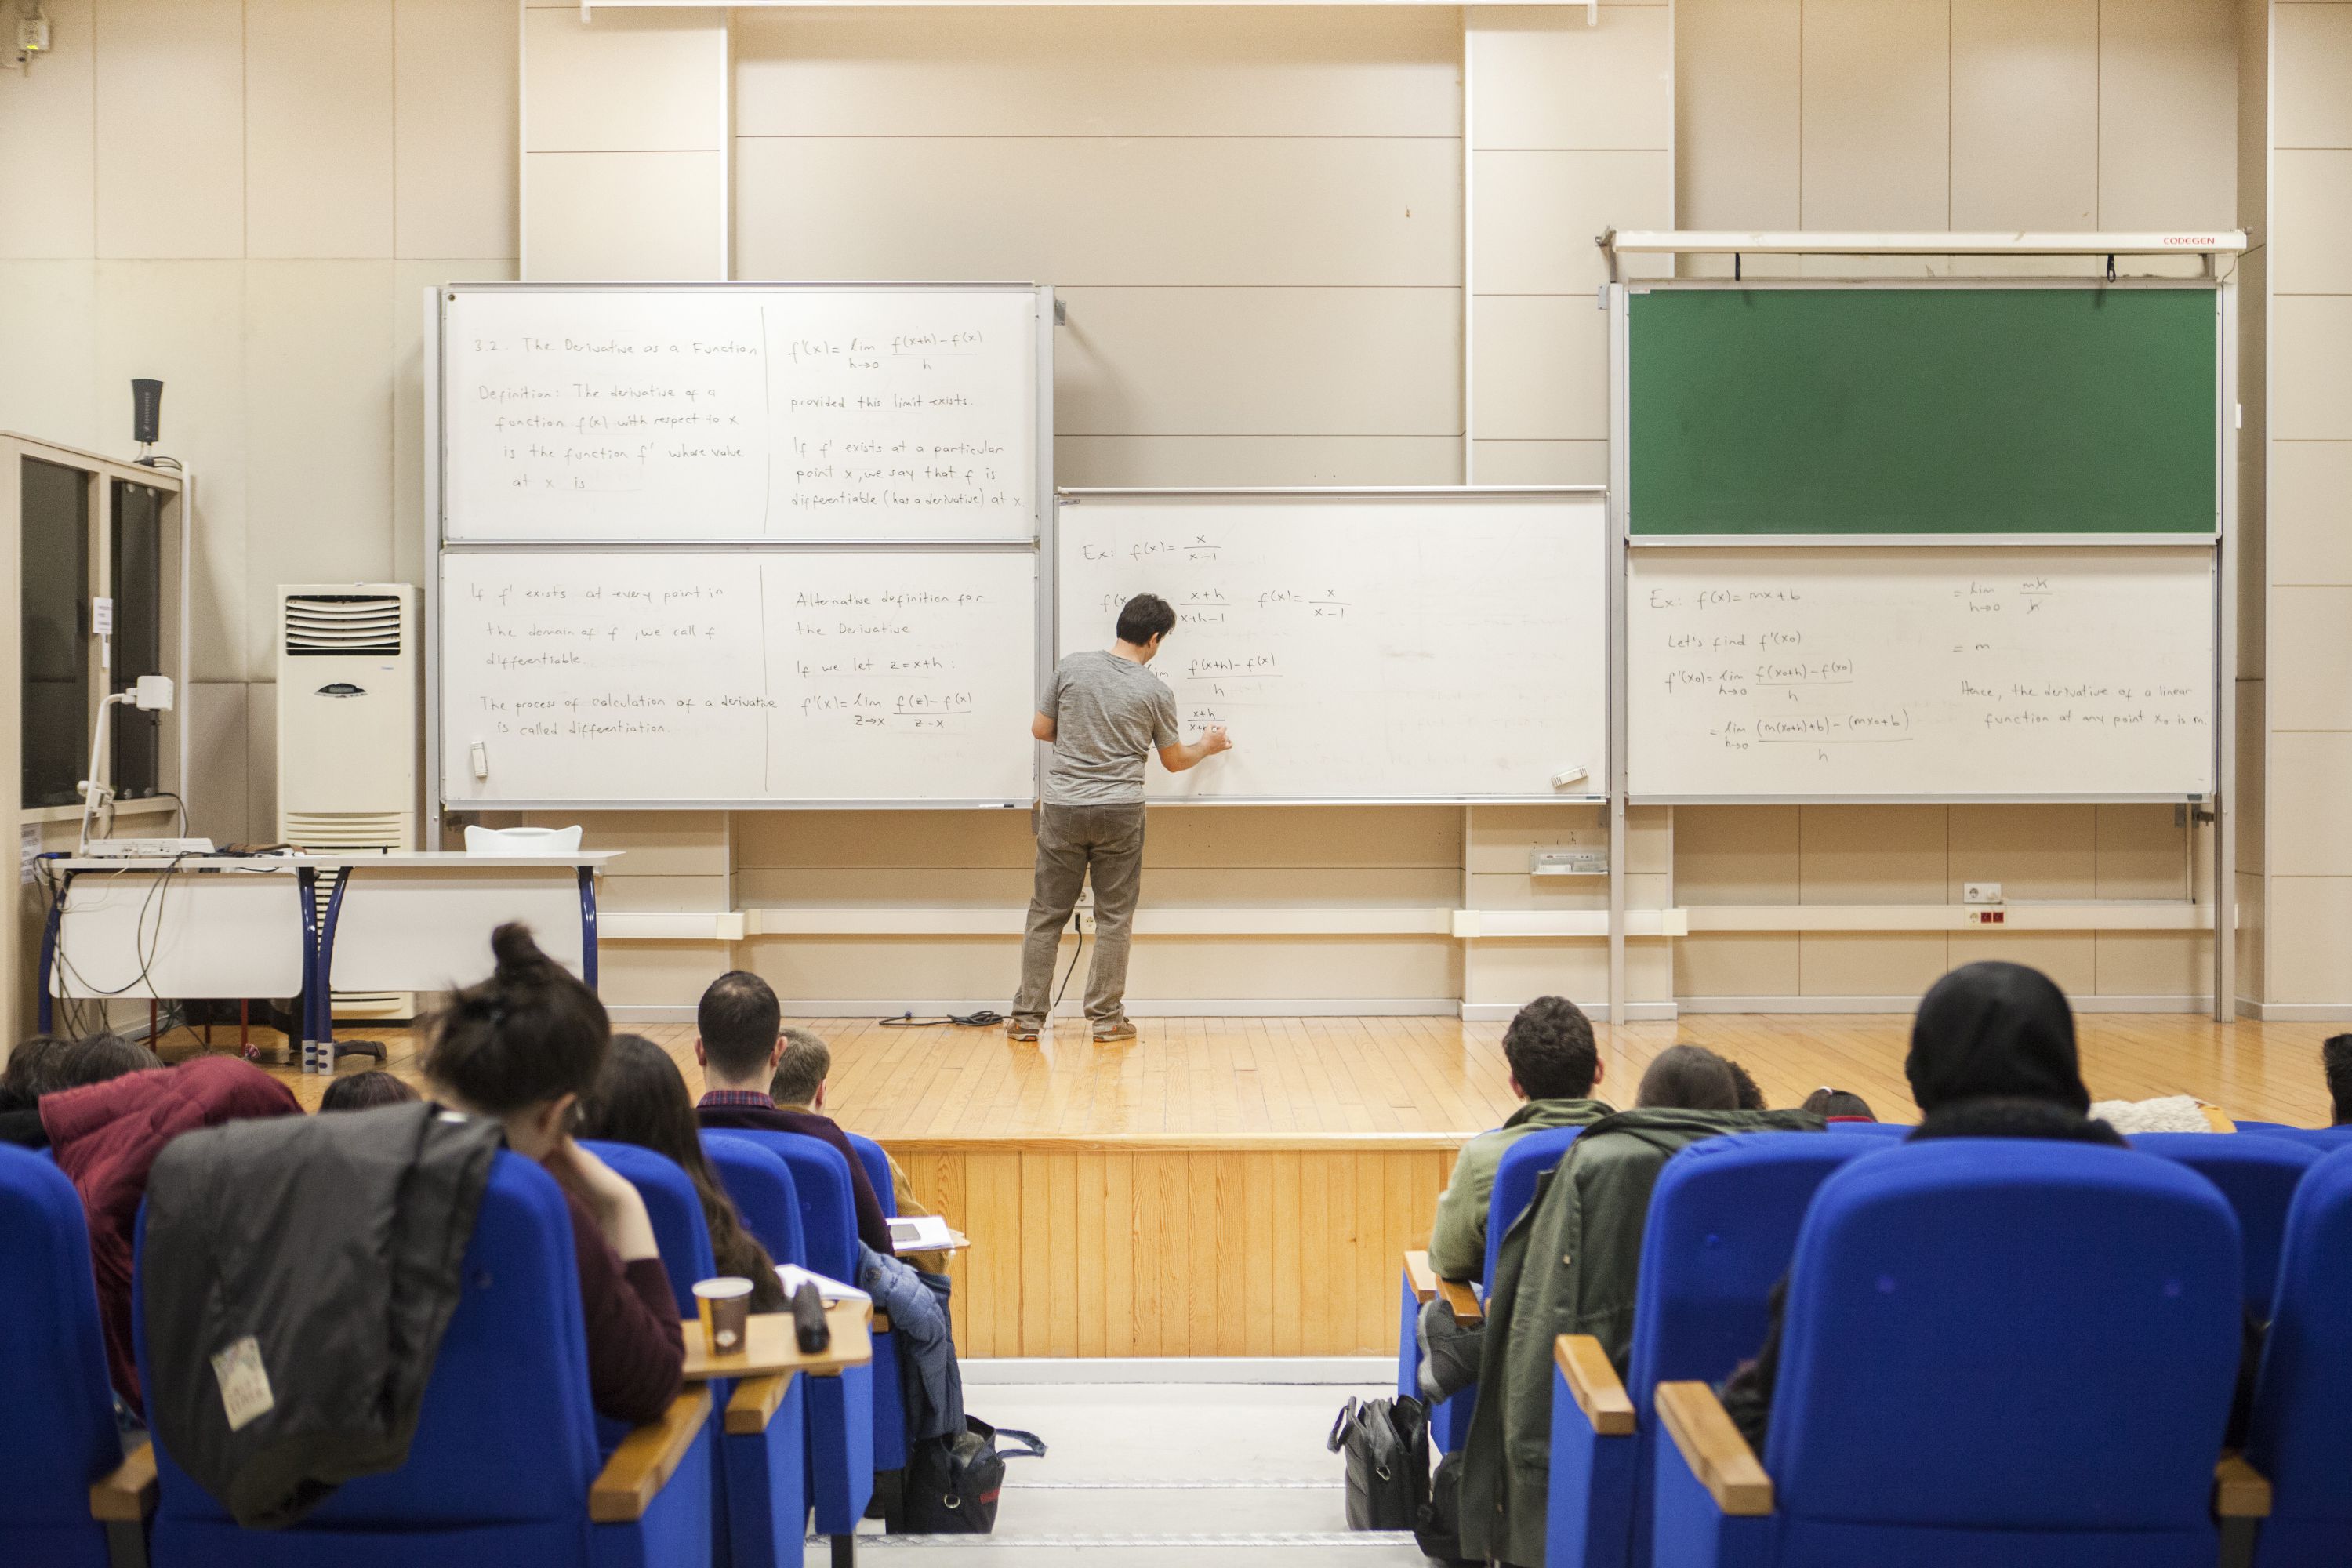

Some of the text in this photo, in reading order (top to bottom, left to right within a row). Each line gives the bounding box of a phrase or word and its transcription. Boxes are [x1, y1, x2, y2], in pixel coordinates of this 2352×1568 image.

[521, 337, 554, 351] The
[564, 338, 633, 354] Derivative
[643, 345, 659, 354] as
[669, 344, 679, 353] a
[692, 340, 757, 355] Function
[572, 383, 600, 398] The
[609, 385, 675, 397] derivative
[684, 389, 698, 402] of
[790, 396, 845, 412] provided
[857, 396, 881, 409] this
[894, 393, 923, 408] limit
[495, 415, 564, 434] function
[617, 414, 648, 427] with
[653, 413, 699, 427] respect
[706, 414, 720, 424] to
[504, 445, 515, 459] is
[529, 444, 554, 457] the
[564, 448, 626, 464] function
[668, 443, 706, 459] whose
[710, 445, 745, 458] value
[844, 439, 882, 453] exists
[891, 440, 906, 453] at
[933, 439, 1004, 457] particular
[512, 474, 532, 487] at
[574, 476, 586, 490] is
[795, 465, 833, 484] point
[888, 469, 914, 482] say
[924, 465, 956, 478] that
[985, 466, 996, 481] is
[925, 487, 984, 508] derivative)
[990, 491, 1010, 505] at
[525, 586, 567, 599] exists
[586, 586, 601, 599] at
[612, 588, 652, 603] every
[663, 586, 700, 603] point
[708, 587, 724, 598] in
[796, 590, 984, 608] Alternative definition for
[486, 622, 516, 637] the
[528, 625, 575, 637] domain
[581, 628, 593, 641] of
[673, 624, 696, 637] call
[795, 621, 909, 636] the Derivative
[1668, 634, 1703, 648] Let's
[1712, 633, 1746, 652] find
[822, 664, 841, 673] we
[853, 657, 873, 671] let
[2011, 684, 2037, 696] the
[2044, 683, 2107, 698] derivative
[2118, 688, 2132, 702] of
[2159, 685, 2193, 697] linear
[480, 695, 508, 710] The
[514, 700, 556, 716] process
[564, 697, 579, 712] of
[591, 692, 666, 708] calculation
[676, 698, 695, 713] of
[720, 695, 777, 709] derivative
[497, 721, 510, 733] is
[519, 721, 558, 735] called
[1984, 710, 2049, 728] function
[2059, 710, 2071, 721] at
[2082, 715, 2104, 724] any
[2113, 710, 2144, 727] point
[2177, 713, 2187, 725] is
